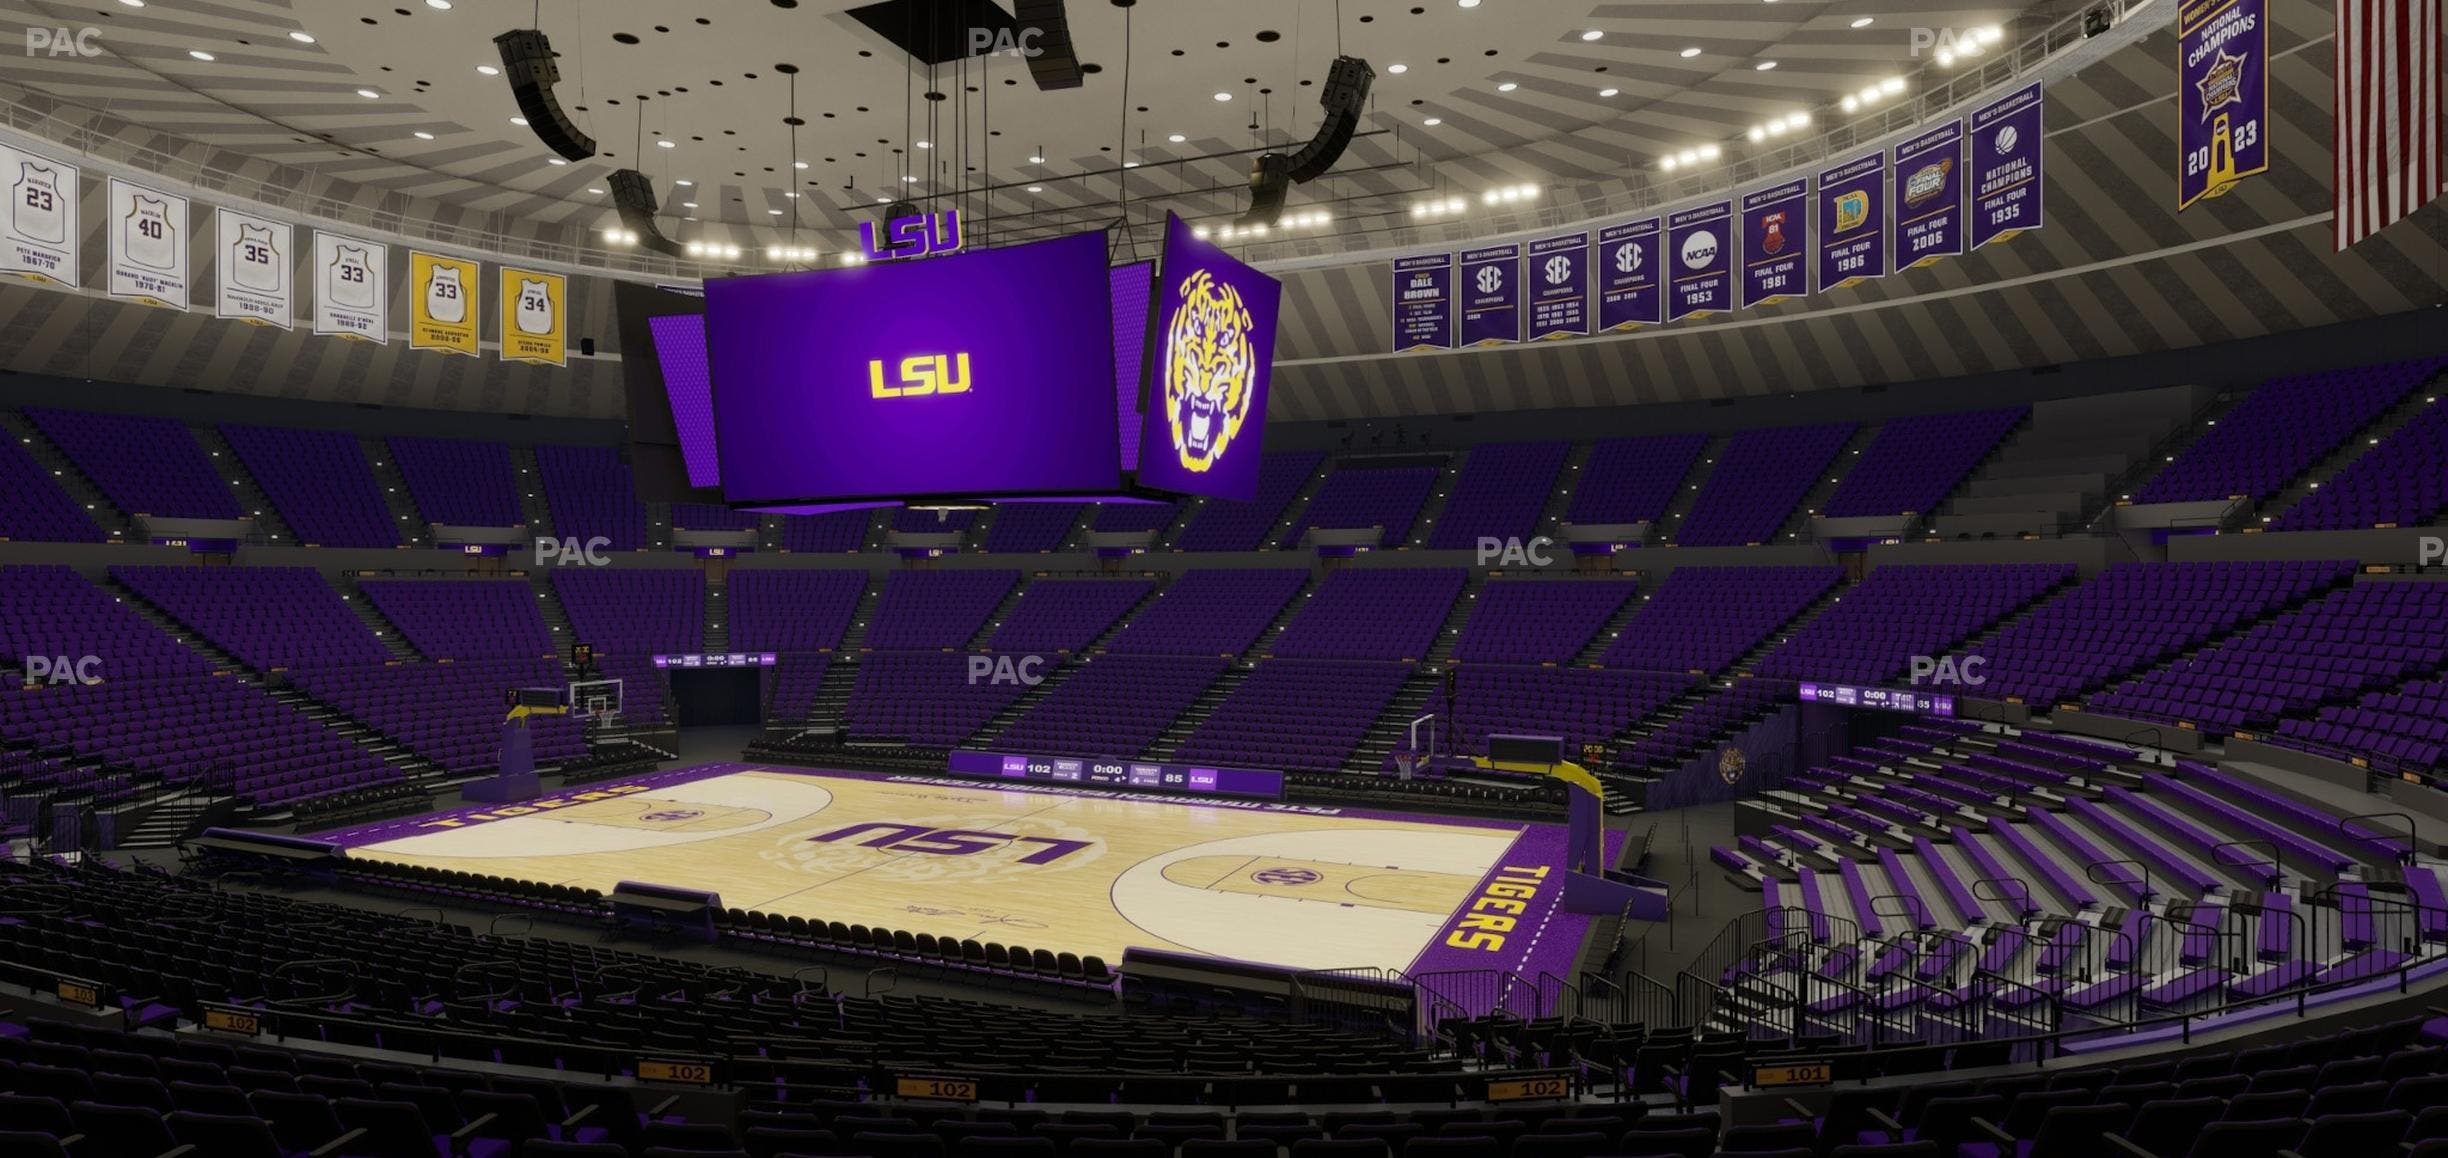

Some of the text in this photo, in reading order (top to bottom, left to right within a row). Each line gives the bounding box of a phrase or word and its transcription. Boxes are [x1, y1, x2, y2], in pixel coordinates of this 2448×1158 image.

[2201, 6, 2242, 41] NATIONAL
[2188, 13, 2256, 68] CHAMPIONS
[2188, 119, 2257, 177] 20 23
[1986, 156, 2027, 181] NATIONAL
[1981, 166, 2032, 194] CHAMPIONS
[27, 187, 52, 211] 23
[1984, 188, 2027, 211] FINAL FOUR
[1991, 204, 2020, 225] 1935
[138, 218, 162, 239] 40
[859, 209, 964, 261] LSU
[1769, 224, 1779, 234] 81
[1907, 217, 1948, 237] FINAL FOUR
[1831, 241, 1871, 259] FINAL FOUR
[1912, 231, 1943, 251] 2006
[245, 244, 269, 265] 35
[1615, 242, 1643, 273] SEC
[1686, 246, 1716, 262] NCAA
[1838, 254, 1865, 272] 1986
[341, 265, 364, 283] 33
[1545, 255, 1571, 284] SEC
[1754, 261, 1794, 278] FINAL FOUR
[1410, 278, 1432, 288] DALE
[1476, 265, 1502, 294] SEC
[1680, 278, 1719, 293] FINAL FOUR
[1762, 275, 1787, 290] 1981
[435, 283, 457, 299] 33
[1404, 288, 1440, 300] BROWN
[1686, 290, 1713, 305] 1953
[525, 296, 545, 312] 34
[869, 352, 970, 399] LSU
[1817, 689, 1834, 698] 102
[1864, 690, 1886, 700] 0:00
[1004, 763, 1214, 785] LSU 102 0:00 85 LSU
[804, 822, 1095, 866] LSU
[1446, 865, 1551, 952] TIGERS
[74, 988, 93, 1001] 103
[227, 1016, 254, 1030] 102
[668, 1066, 706, 1080] 102
[1786, 1066, 1825, 1081] 101
[930, 1082, 970, 1097] 102
[1520, 1082, 1561, 1096] 102
